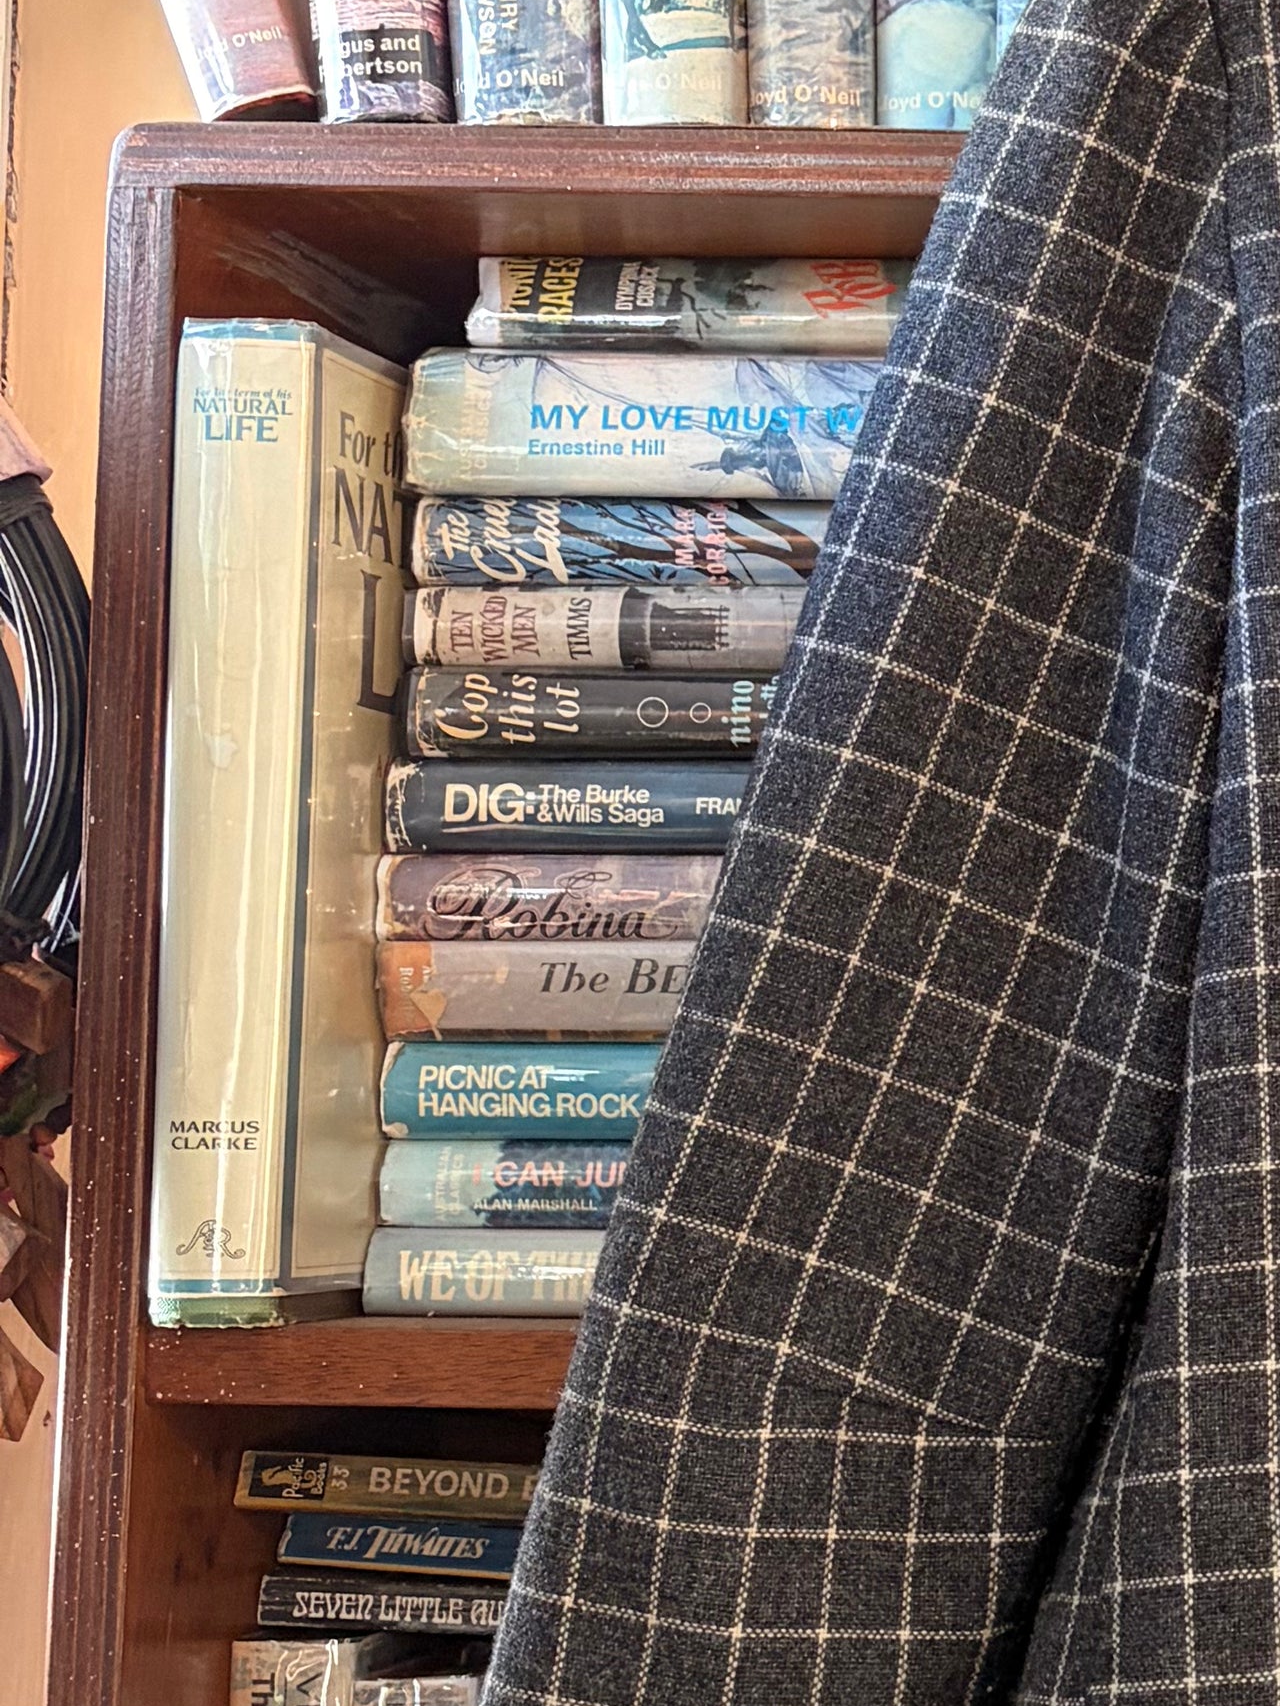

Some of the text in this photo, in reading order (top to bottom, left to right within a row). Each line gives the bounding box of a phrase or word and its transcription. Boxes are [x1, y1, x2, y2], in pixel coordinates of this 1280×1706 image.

[232, 27, 283, 48] O'Neil
[379, 33, 421, 54] and
[496, 67, 565, 88] O'Neil
[537, 256, 584, 323] RACES
[636, 265, 660, 308] CUSACK
[193, 398, 293, 416] NATURAL
[530, 404, 815, 433] MY LOVE MUST
[204, 415, 279, 443] LIFE
[528, 438, 667, 457] Ernestine Hill
[450, 609, 475, 654] TEN
[479, 594, 509, 665] WICKED
[510, 603, 541, 658] MEN
[566, 596, 593, 662] TIMMS
[539, 960, 610, 994] The
[417, 1092, 642, 1119] HANGING ROCK
[169, 1119, 260, 1135] MARCUS
[170, 1136, 258, 1151] CLARKE
[472, 1197, 598, 1212] ALAN MARSHALL
[399, 1249, 524, 1302] WE OF
[367, 1465, 510, 1500] BEYOND
[325, 1524, 490, 1560] F.J. THWAITES
[291, 1591, 465, 1626] SEVEN LITTLE
